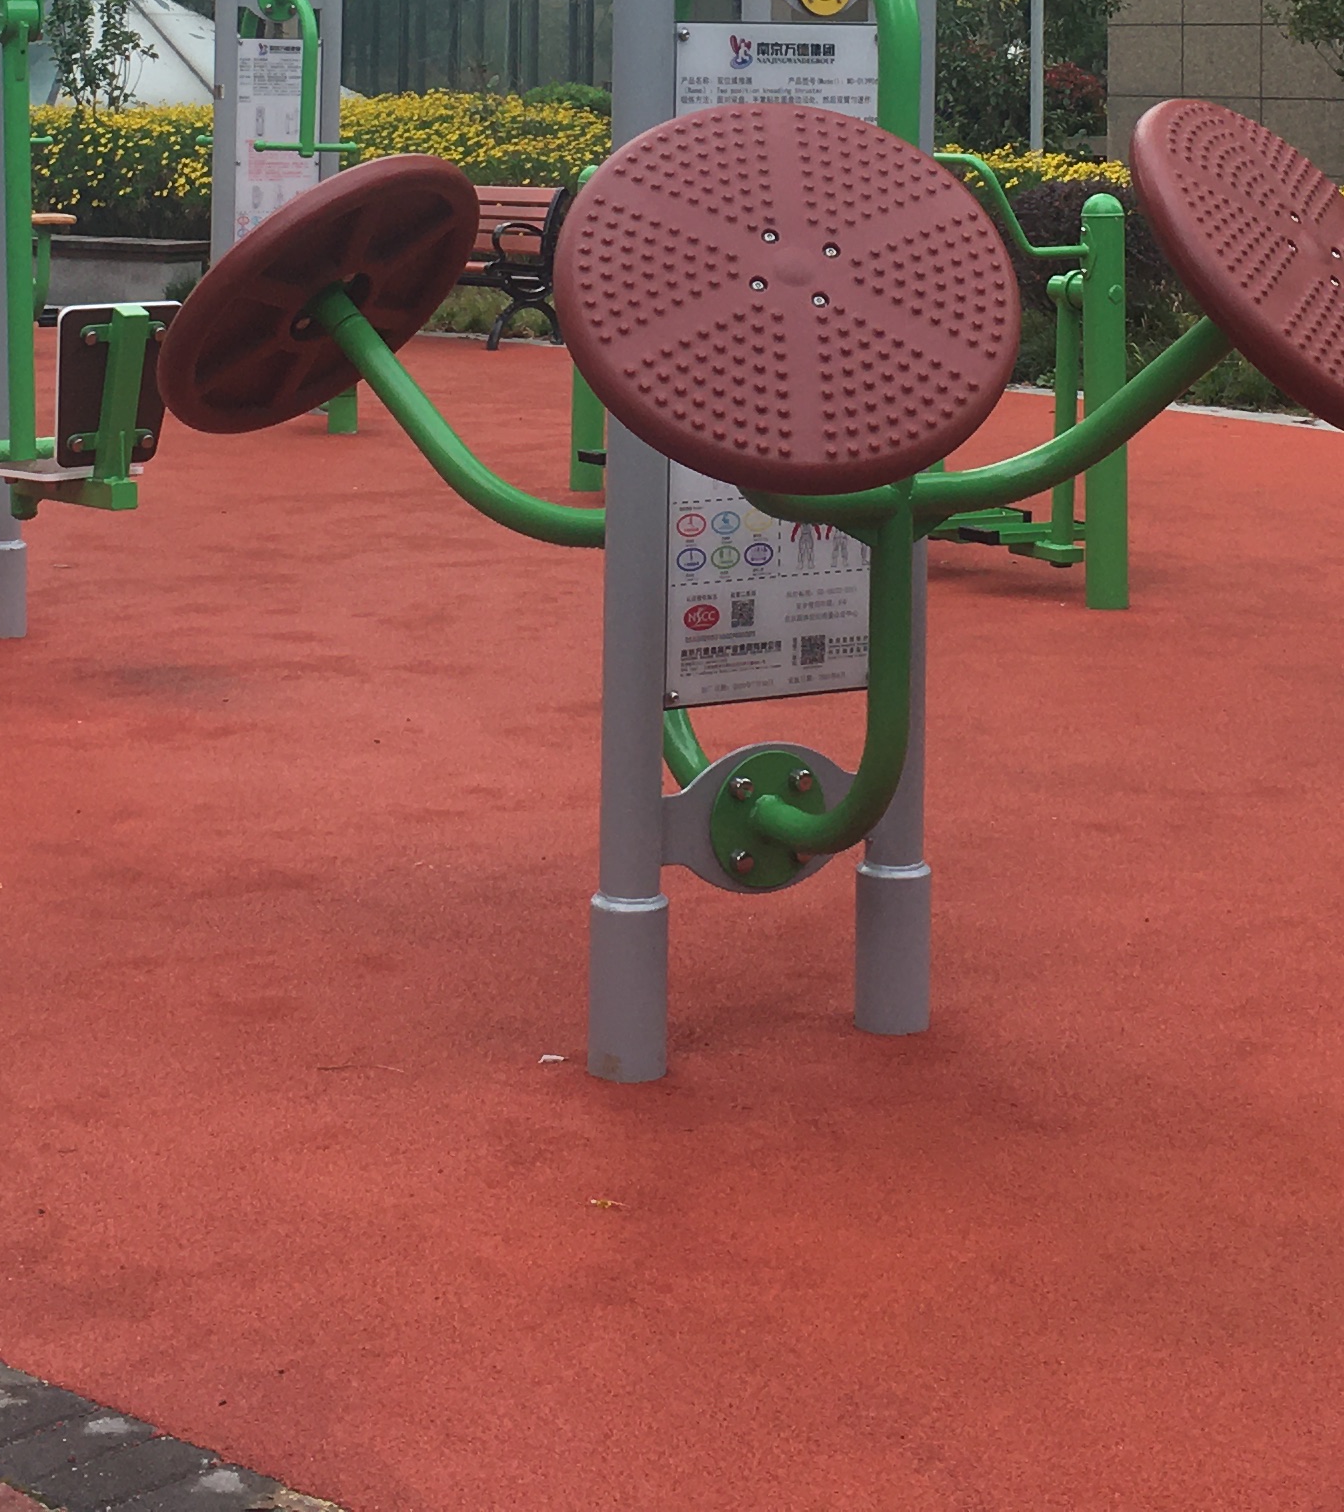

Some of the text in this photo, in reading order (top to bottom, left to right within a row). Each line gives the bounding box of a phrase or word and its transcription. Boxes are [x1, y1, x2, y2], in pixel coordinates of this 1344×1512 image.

[756, 42, 836, 57] 南京万德集团
[756, 57, 835, 65] NANJINGWANDEGROUP
